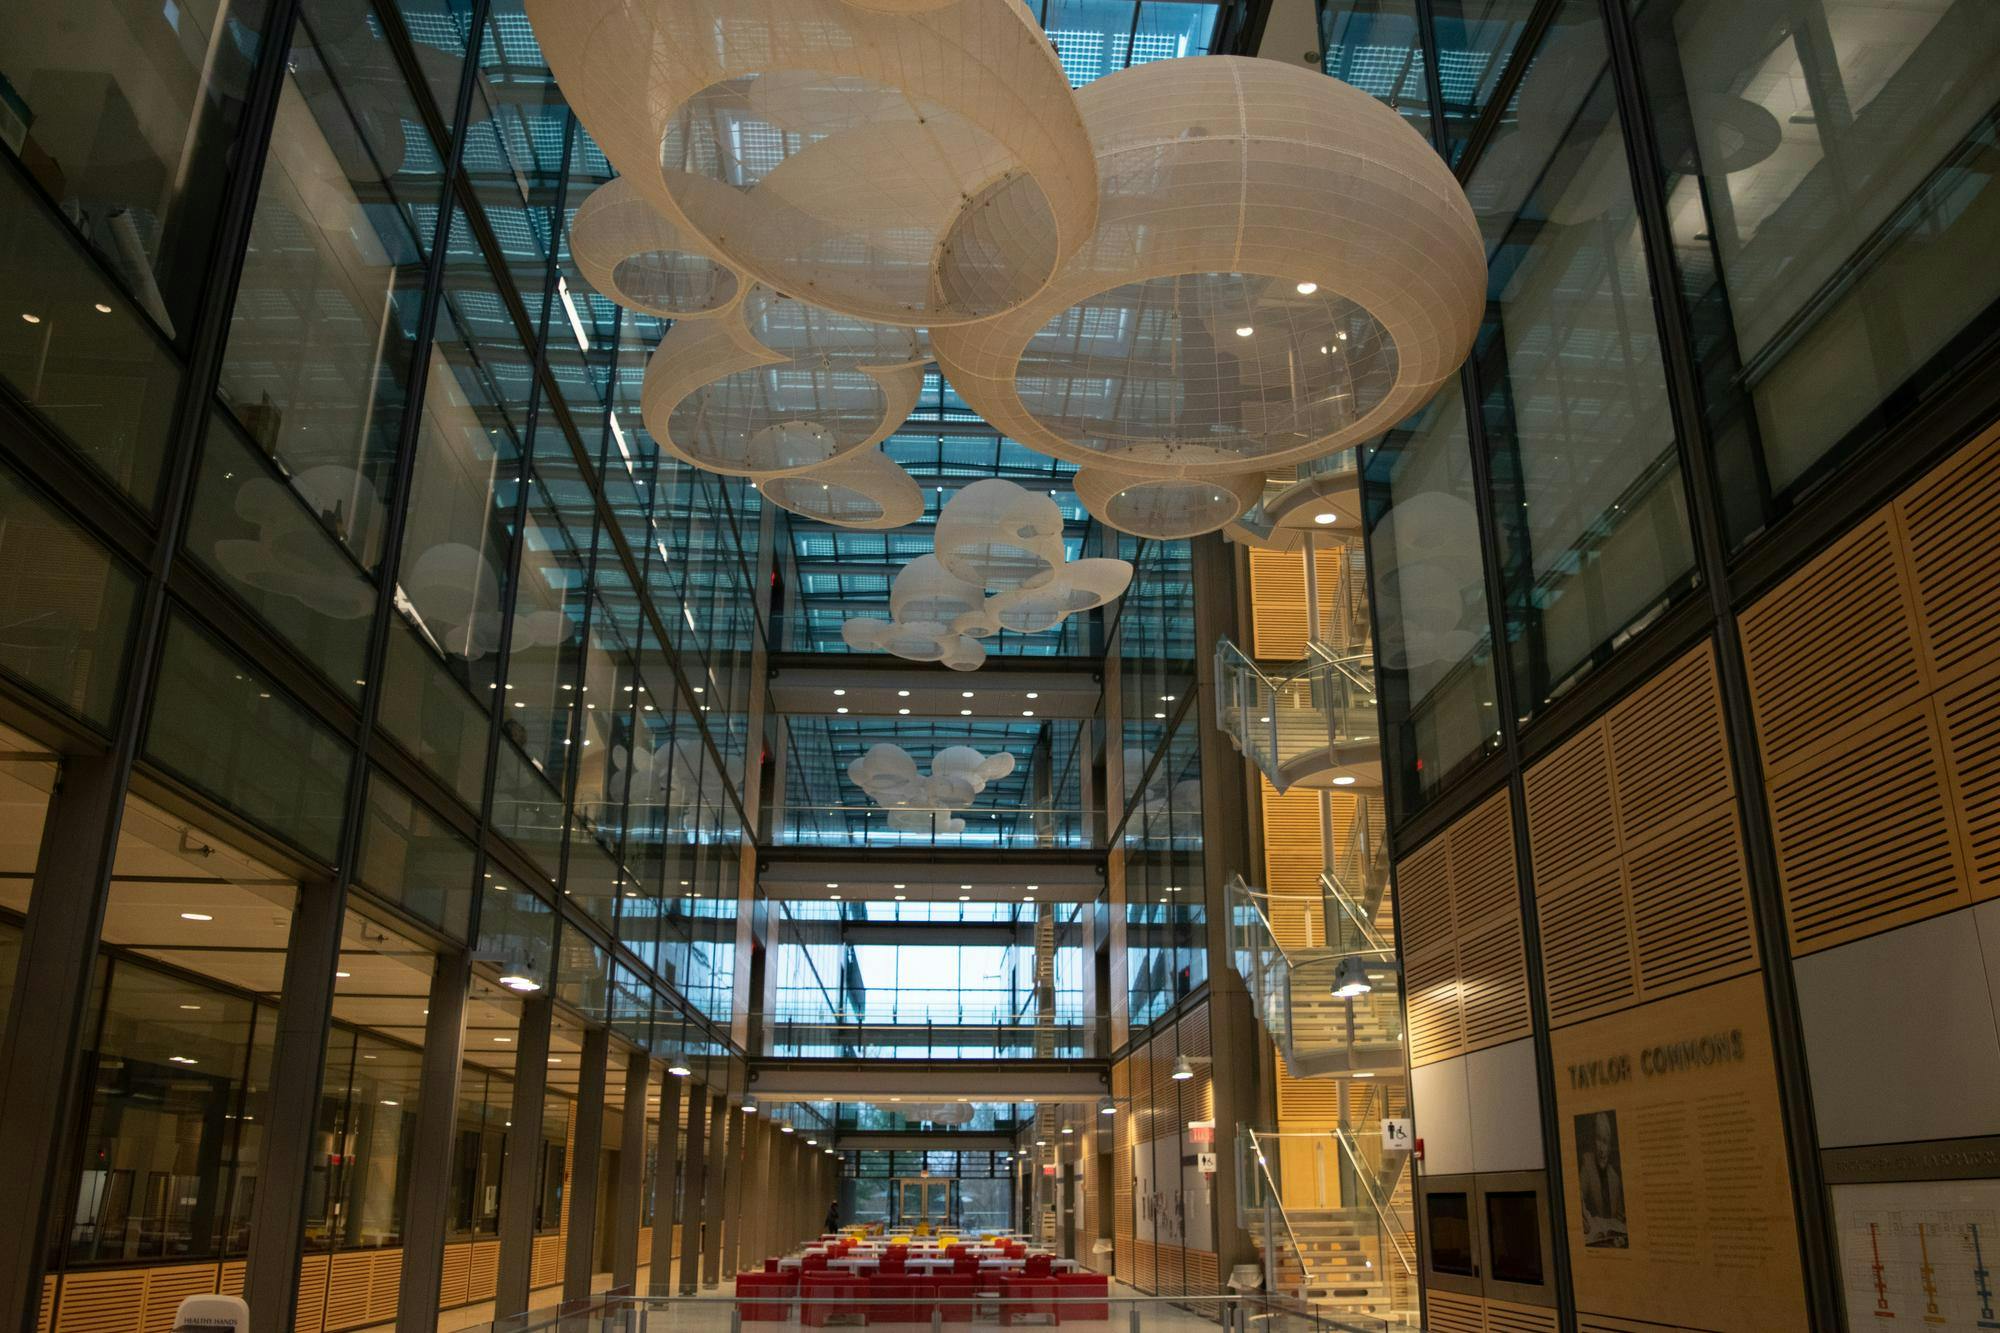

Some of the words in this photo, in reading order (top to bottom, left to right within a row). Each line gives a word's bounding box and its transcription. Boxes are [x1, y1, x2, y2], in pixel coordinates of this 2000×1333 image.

[1568, 1053, 1633, 1090] TAYLOR
[1640, 1029, 1745, 1077] COMMONS
[184, 1317, 212, 1325] HEALTHY
[214, 1318, 238, 1326] HANDS
